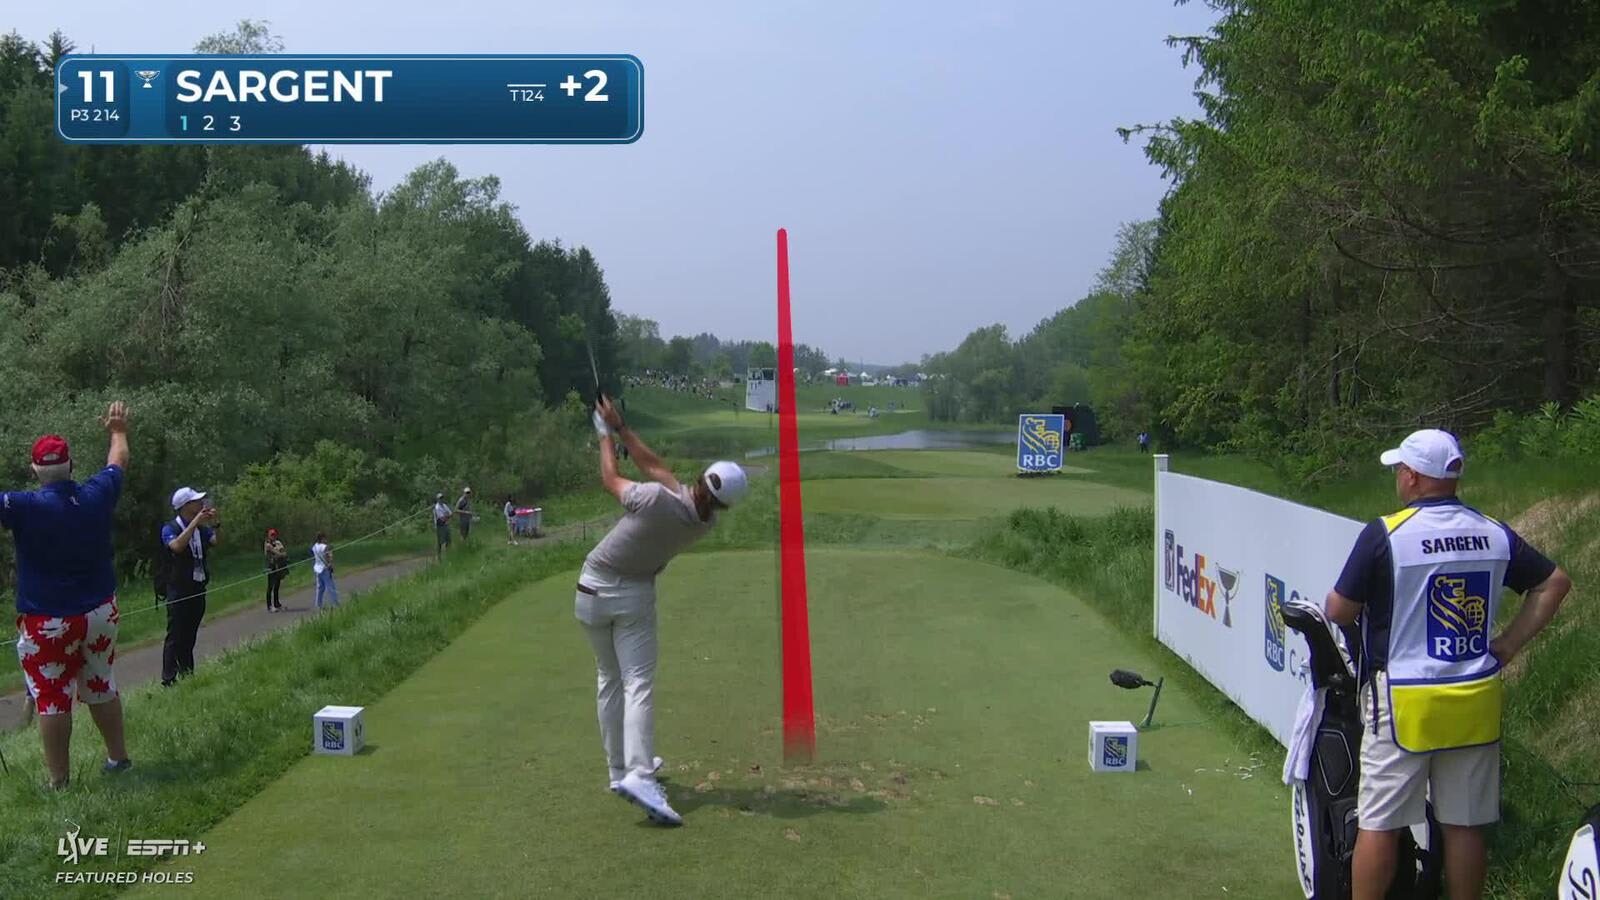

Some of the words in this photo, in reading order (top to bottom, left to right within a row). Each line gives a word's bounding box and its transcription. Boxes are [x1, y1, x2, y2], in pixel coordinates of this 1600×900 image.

[1023, 454, 1058, 467] RBC
[1421, 535, 1491, 555] SARGENT
[1176, 544, 1217, 620] FedEx
[1266, 638, 1284, 668] RBC
[1433, 634, 1484, 657] RBC
[324, 740, 343, 749] RBC
[1105, 757, 1126, 765] RBC
